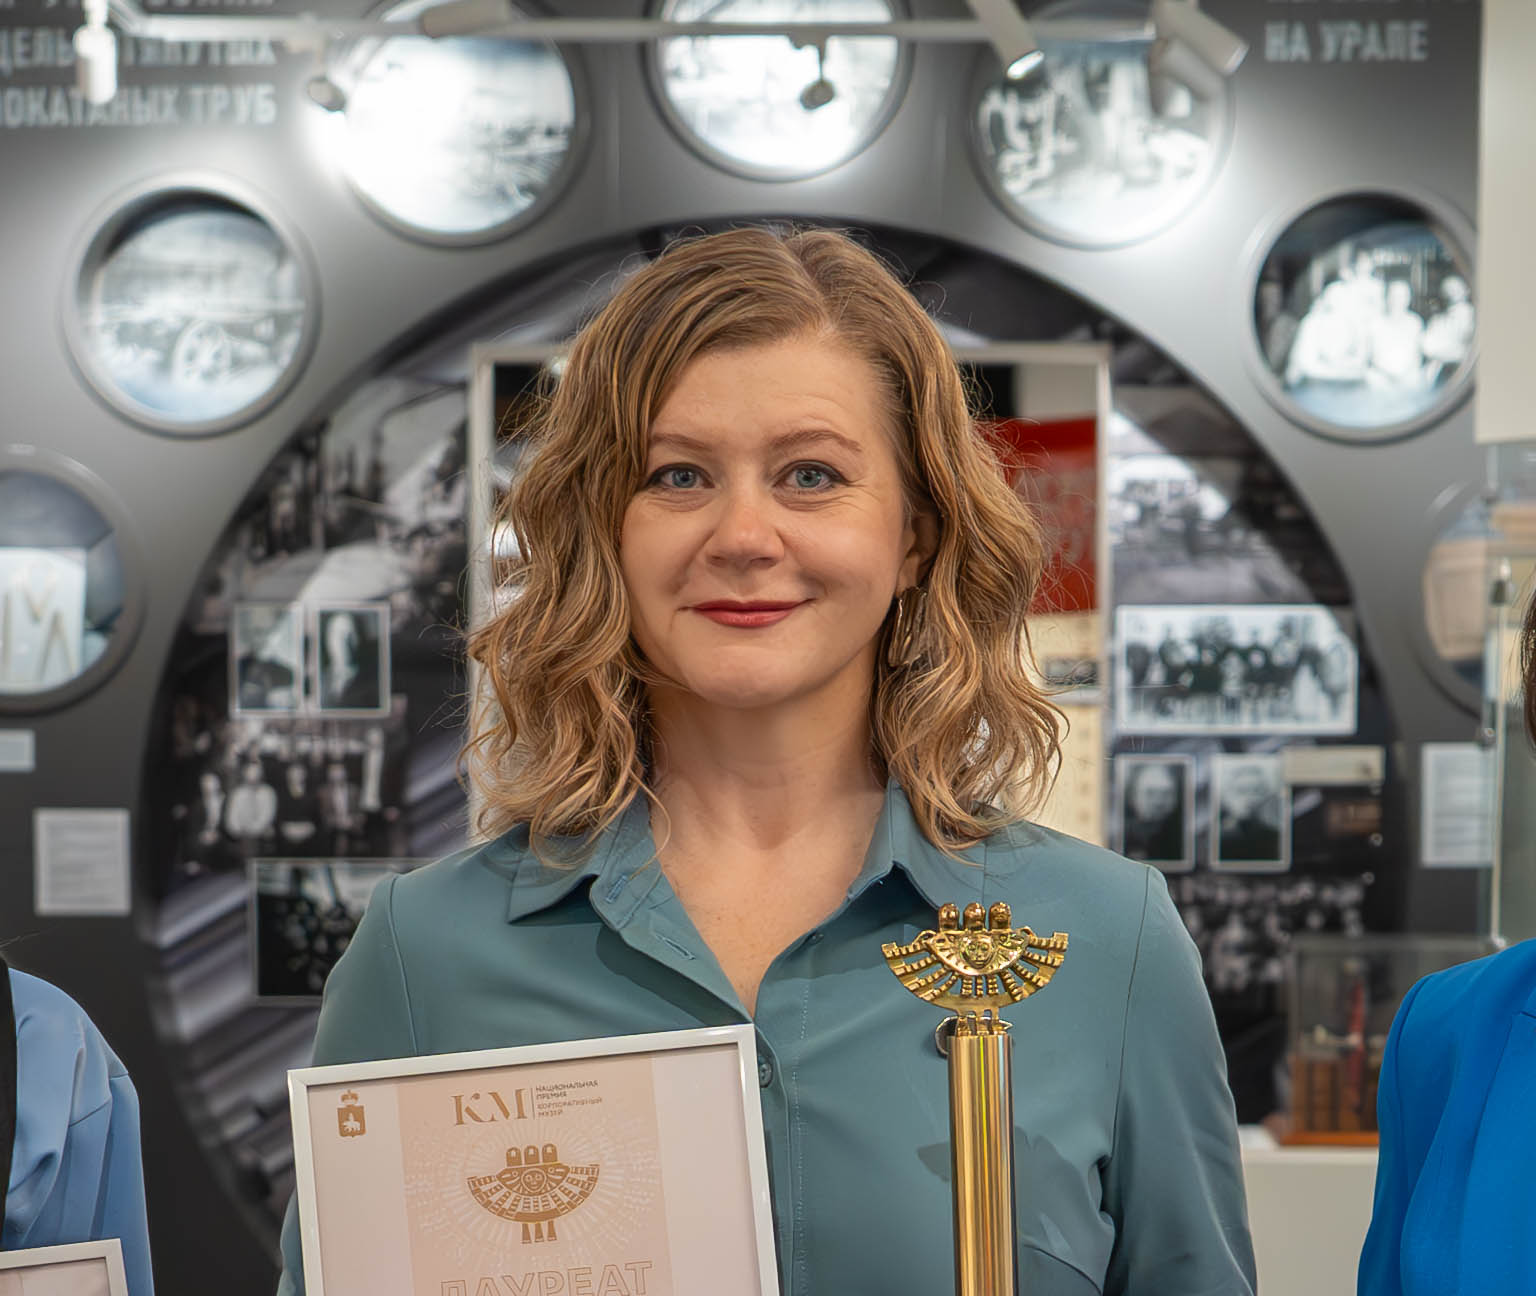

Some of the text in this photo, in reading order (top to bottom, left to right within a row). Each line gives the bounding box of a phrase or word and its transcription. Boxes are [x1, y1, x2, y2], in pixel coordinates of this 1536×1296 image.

[1265, 20, 1429, 62] НА УРАЛЕ
[184, 86, 277, 126] ТРУБ
